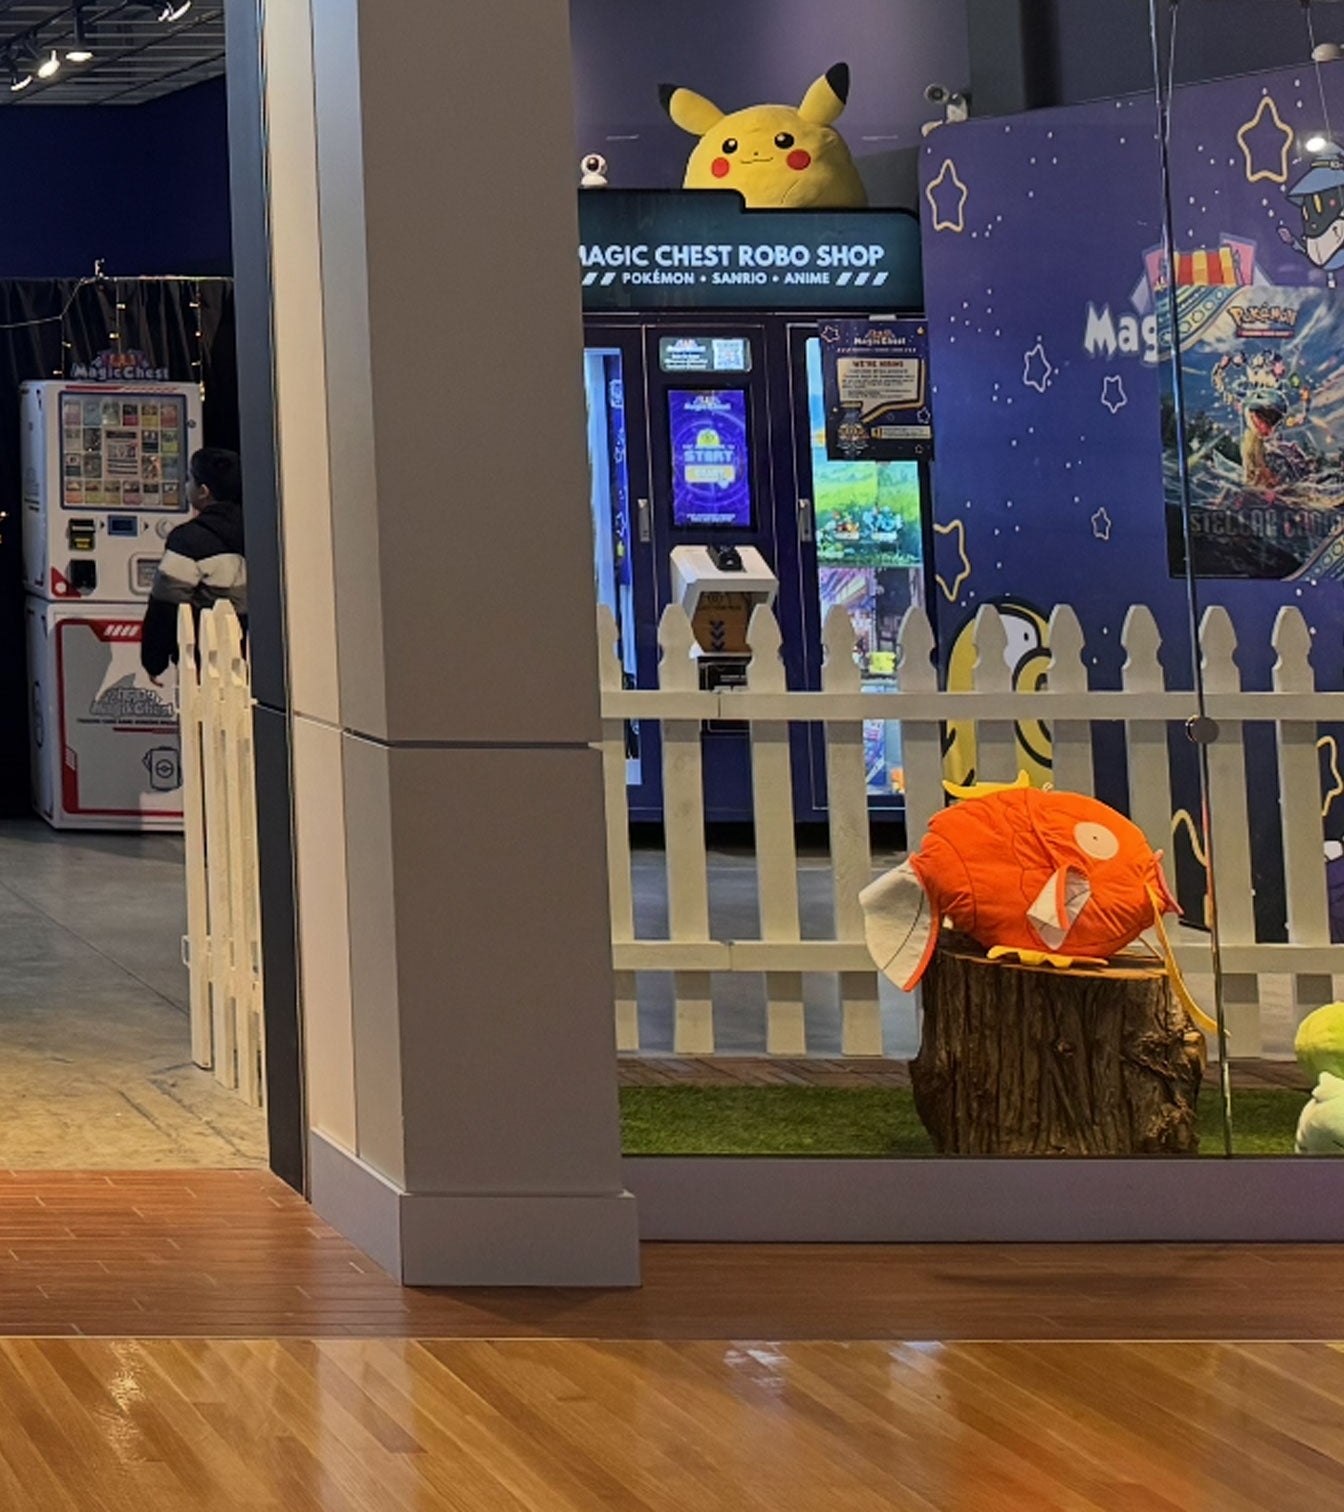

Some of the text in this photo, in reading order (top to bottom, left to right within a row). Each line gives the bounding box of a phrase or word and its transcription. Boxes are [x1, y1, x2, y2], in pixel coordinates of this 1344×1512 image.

[655, 245, 733, 267] CHEST
[738, 245, 810, 267] ROBO
[816, 245, 886, 267] SHOP
[621, 269, 830, 285] POKÉMON SANRIO ANIME
